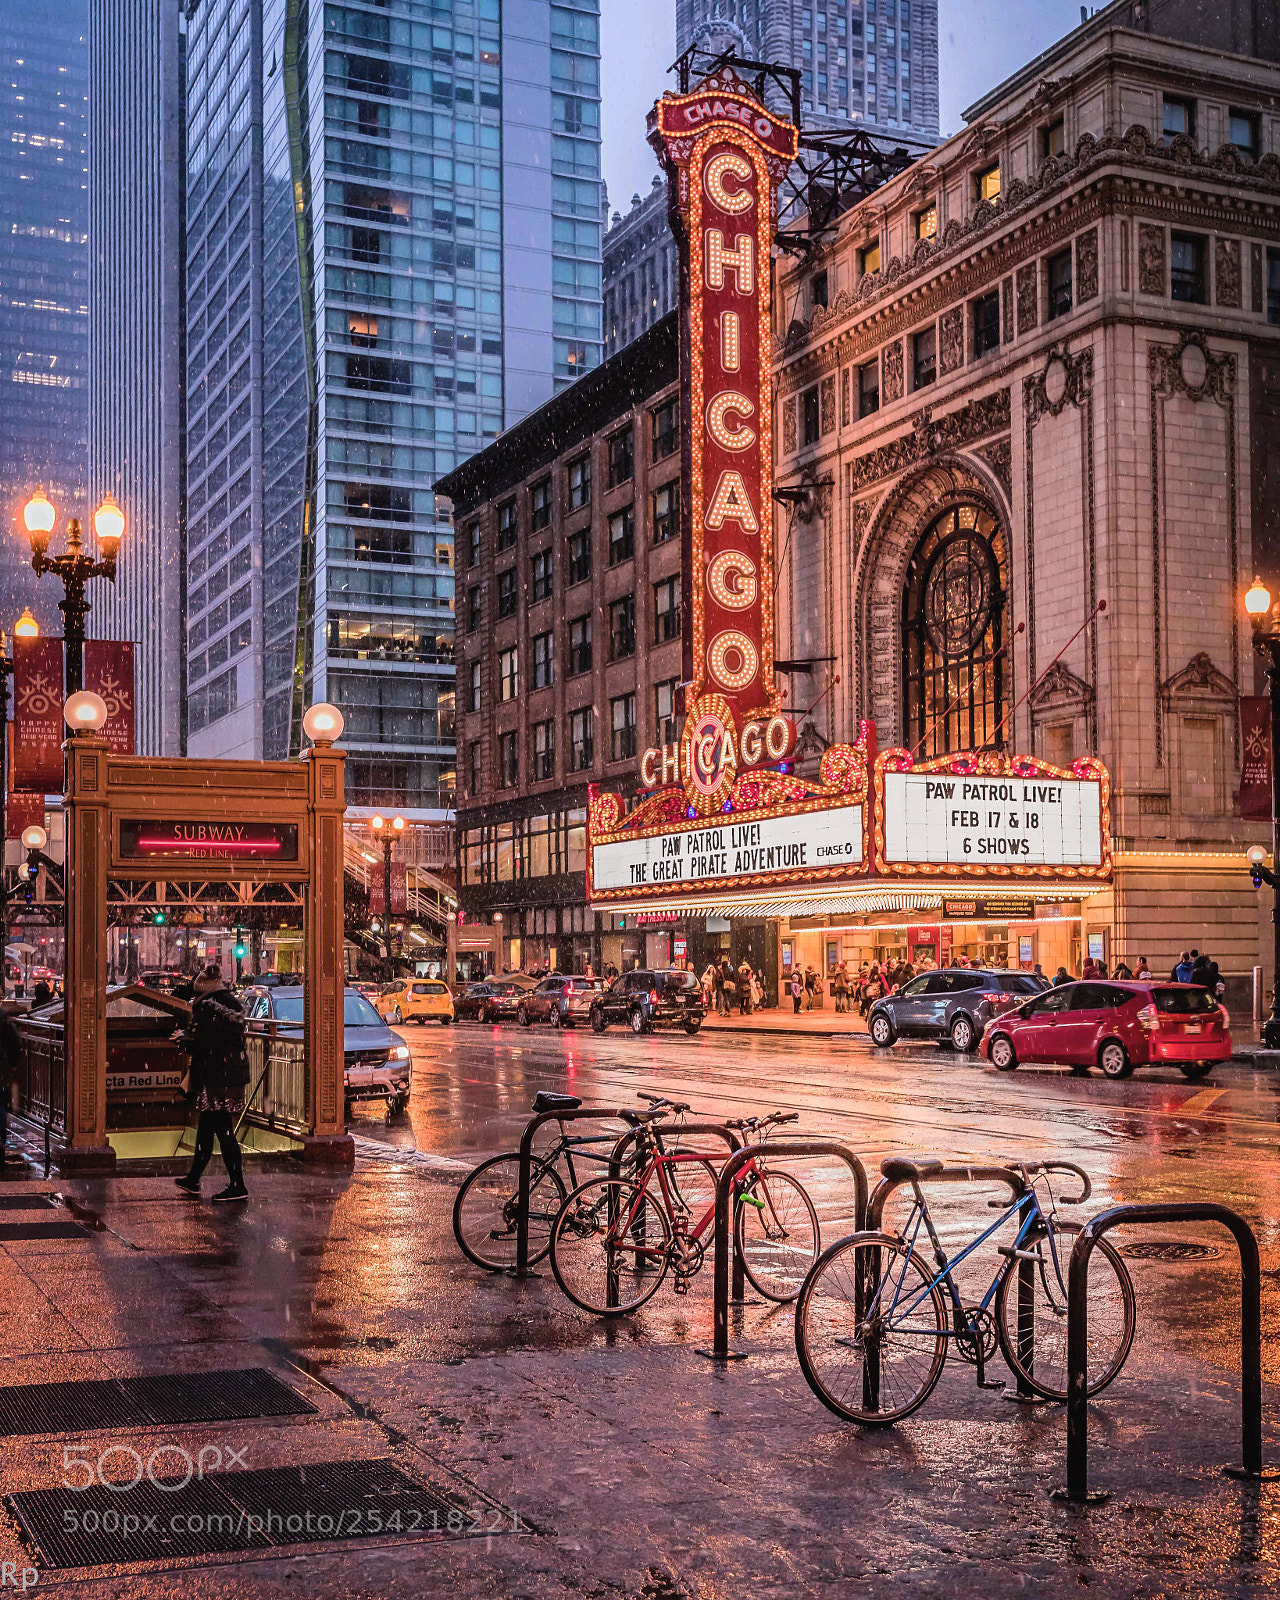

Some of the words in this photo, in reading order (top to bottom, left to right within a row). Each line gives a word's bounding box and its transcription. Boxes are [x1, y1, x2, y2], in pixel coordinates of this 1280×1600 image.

[683, 101, 753, 126] CHASE
[704, 153, 759, 691] CHICAGO
[641, 715, 790, 788] CHICAGO
[926, 782, 956, 800] PAW
[962, 783, 1017, 802] PATROL
[1023, 785, 1062, 803] LIVE!
[951, 810, 979, 828] FEB
[988, 811, 1001, 828] 17
[1008, 813, 1020, 829] &
[1025, 812, 1039, 829] 18
[174, 824, 244, 842] SUBWAY
[661, 835, 682, 857] PAW
[687, 829, 726, 854] PATROL
[731, 824, 761, 849] LIVE!
[816, 844, 844, 857] CHASE
[963, 837, 972, 854] 6
[977, 838, 1030, 855] SHOWS
[629, 862, 647, 884] THE
[652, 859, 684, 881] GREAT
[690, 853, 728, 878] PIRATE
[734, 843, 807, 873] ADVENTURE
[105, 1076, 125, 1087] cta
[129, 1075, 152, 1086] Red
[156, 1074, 179, 1085] Line
